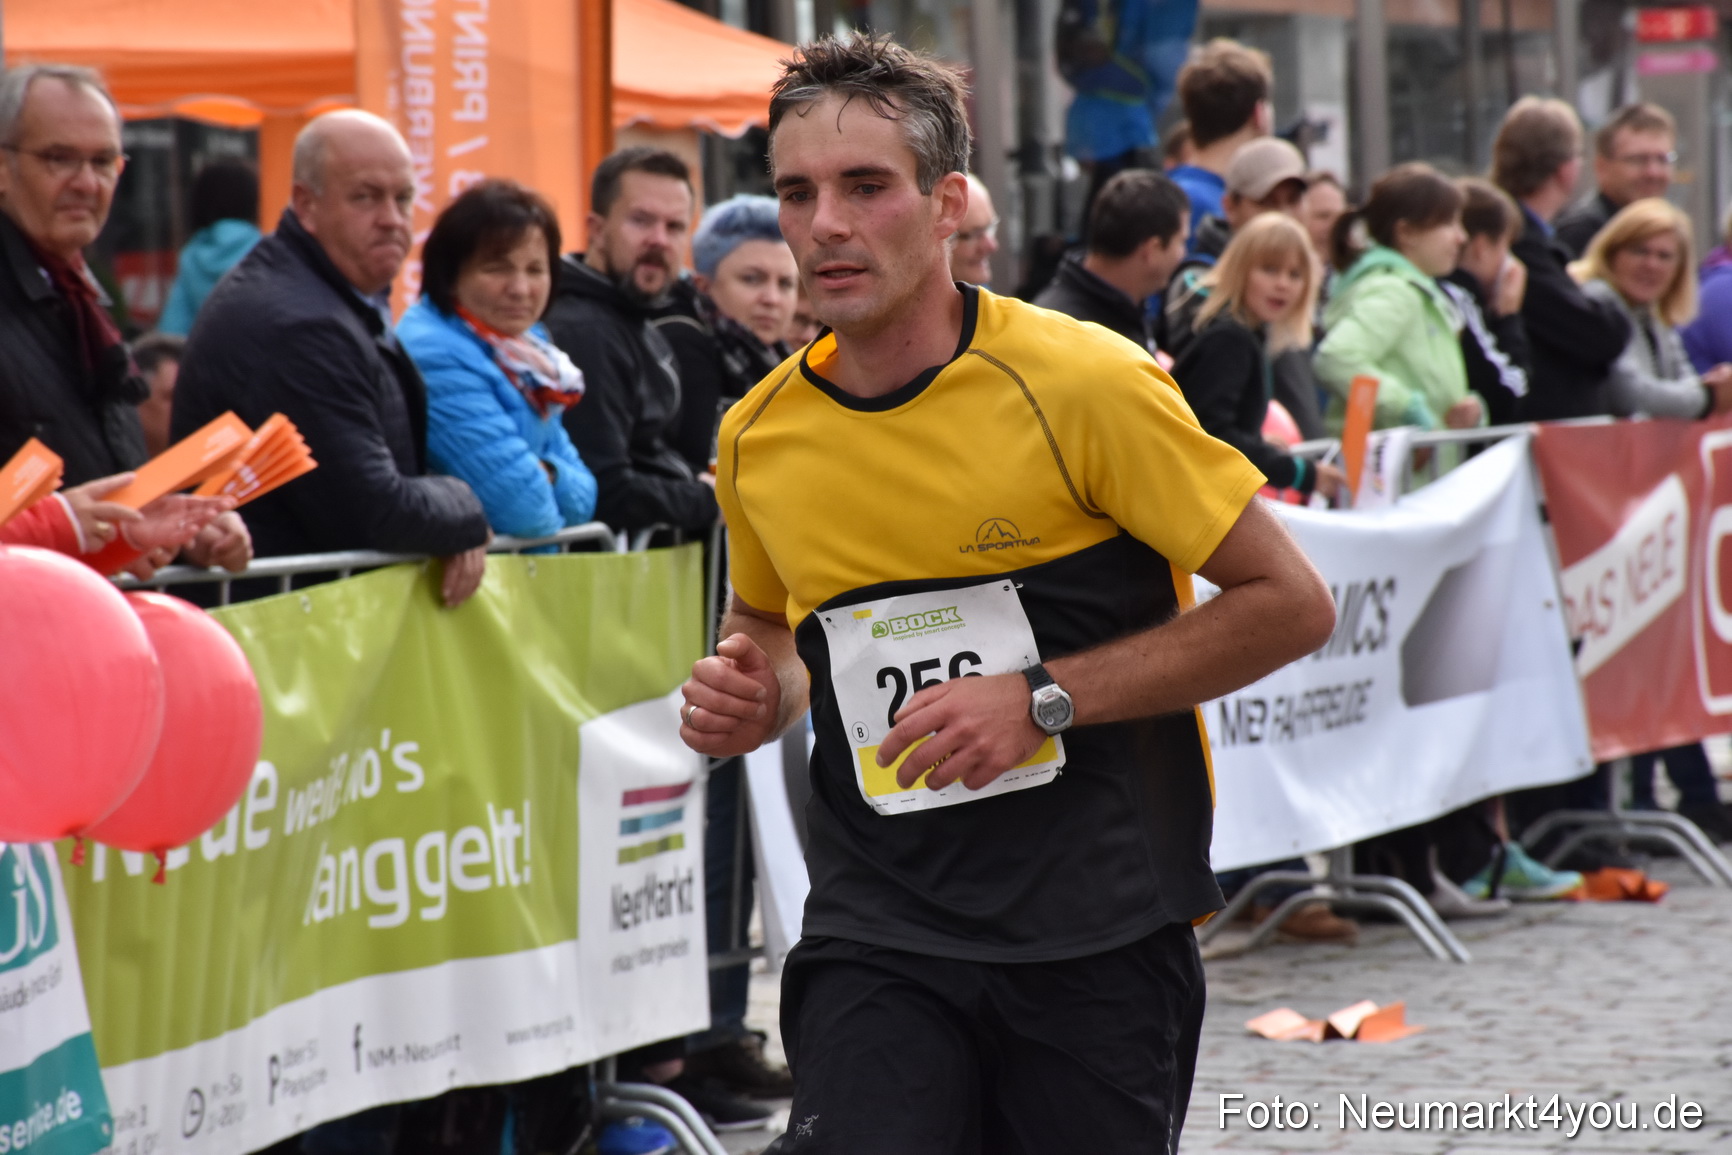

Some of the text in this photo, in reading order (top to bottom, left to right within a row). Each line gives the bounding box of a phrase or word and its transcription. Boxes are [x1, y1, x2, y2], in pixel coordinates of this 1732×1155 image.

[977, 536, 1041, 553] SPORTIVA
[888, 606, 963, 635] BOCK
[893, 622, 966, 641] inspired by smart concepts
[857, 727, 864, 738] B
